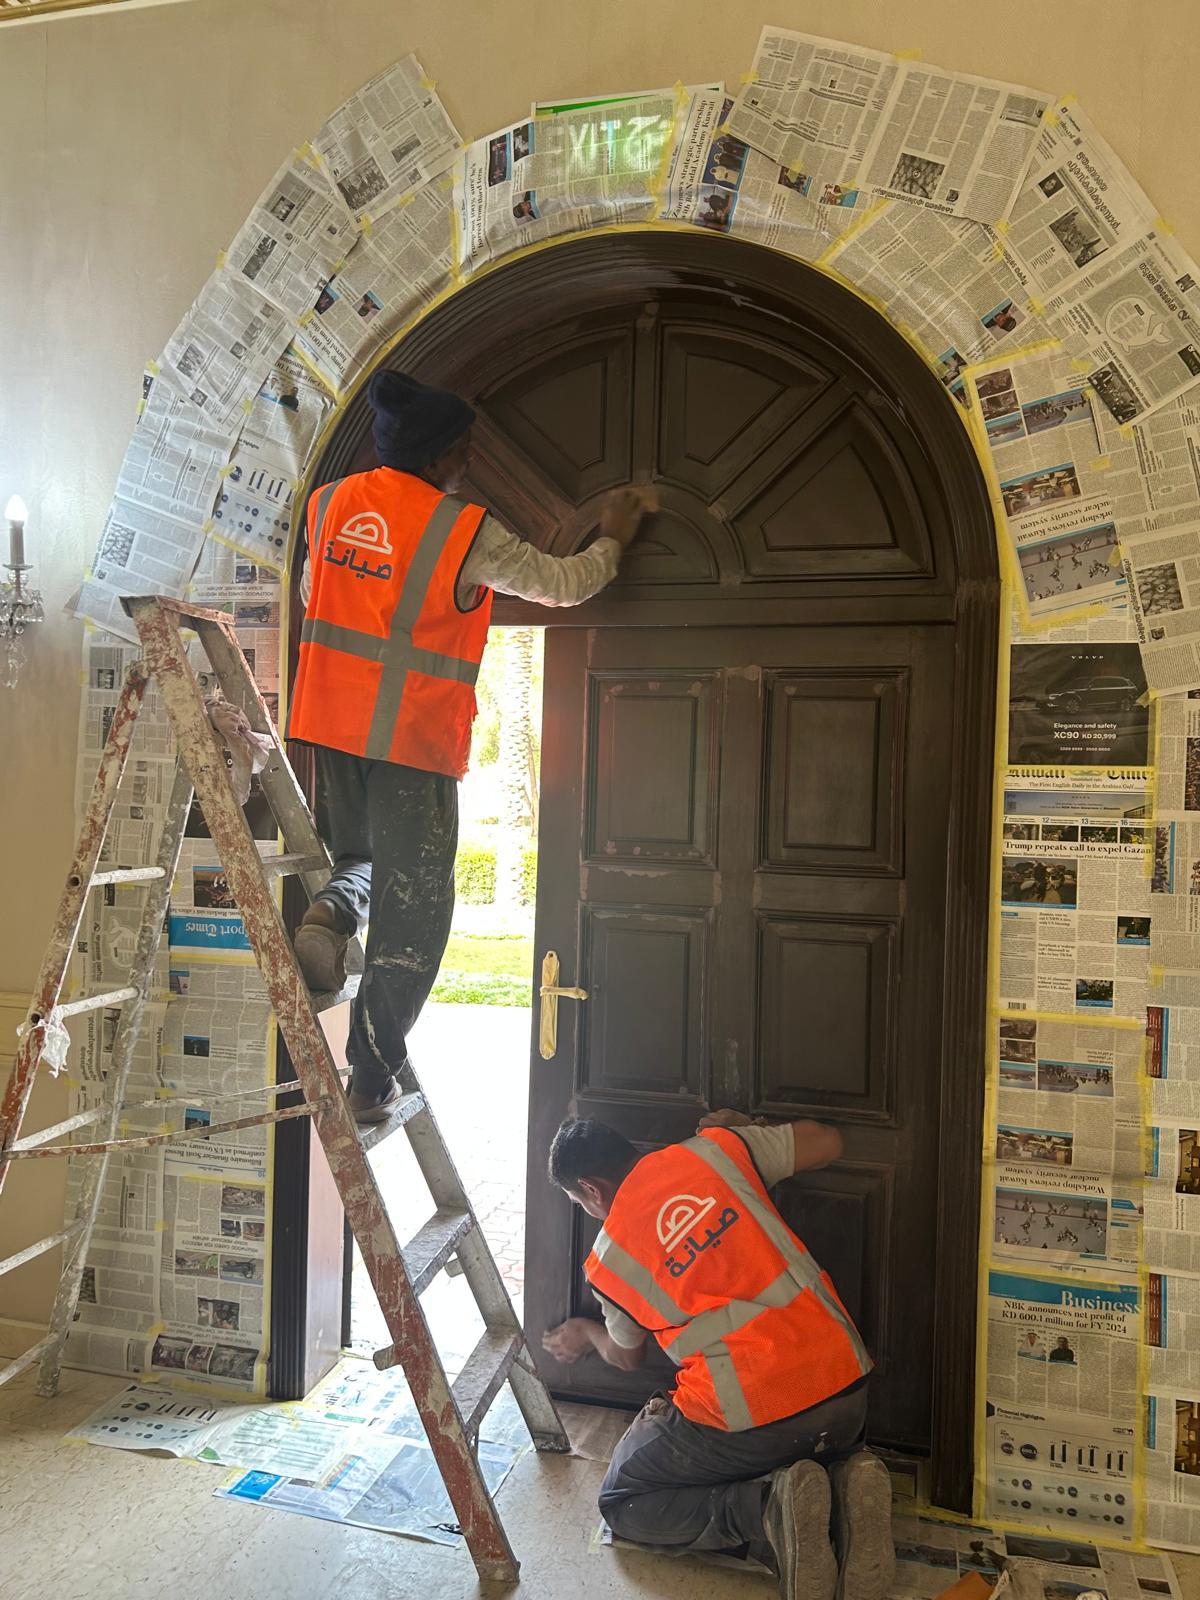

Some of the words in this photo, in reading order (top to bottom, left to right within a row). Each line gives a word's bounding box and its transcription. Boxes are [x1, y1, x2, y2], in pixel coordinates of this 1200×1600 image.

[686, 166, 698, 190] Nadal
[693, 130, 708, 165] Academy
[702, 101, 715, 128] Kuwait
[673, 199, 682, 218] Zain
[681, 147, 693, 180] strategic
[691, 100, 707, 144] partnership
[477, 224, 485, 248] barred
[318, 330, 332, 345] from
[1083, 500, 1110, 513] uclear
[1050, 506, 1083, 522] security
[1079, 509, 1113, 525] orkshop
[1020, 516, 1049, 531] system
[1047, 519, 1079, 534] reviews
[1017, 528, 1047, 542] Kuwait
[1006, 842, 1033, 851] Trump
[1035, 842, 1067, 852] repeats
[1070, 844, 1084, 852] call
[1098, 846, 1121, 854] expel
[185, 922, 217, 937] Times
[189, 1143, 213, 1152] treasury
[233, 1149, 265, 1159] confirmed
[186, 1151, 201, 1159] Scott
[203, 1154, 228, 1163] financier
[230, 1156, 262, 1167] Billionaire
[1005, 1166, 1033, 1176] system
[1036, 1169, 1067, 1180] security
[999, 1175, 1028, 1185] Kuwait
[1029, 1178, 1061, 1188] reviews
[1070, 1174, 1099, 1184] nuclear
[1062, 1180, 1105, 1194] Workshop
[665, 1208, 739, 1277] صيانة
[1061, 1291, 1141, 1314] Business
[1004, 1301, 1024, 1310] NBK
[1028, 1306, 1072, 1317] announces
[1090, 1312, 1113, 1322] profit
[1116, 1314, 1126, 1322] of
[1002, 1311, 1017, 1320] KD
[1019, 1313, 1043, 1323] 600.1
[1046, 1315, 1073, 1327] million
[1076, 1320, 1088, 1330] for
[1090, 1322, 1102, 1330] FY
[1106, 1323, 1126, 1334] 2024
